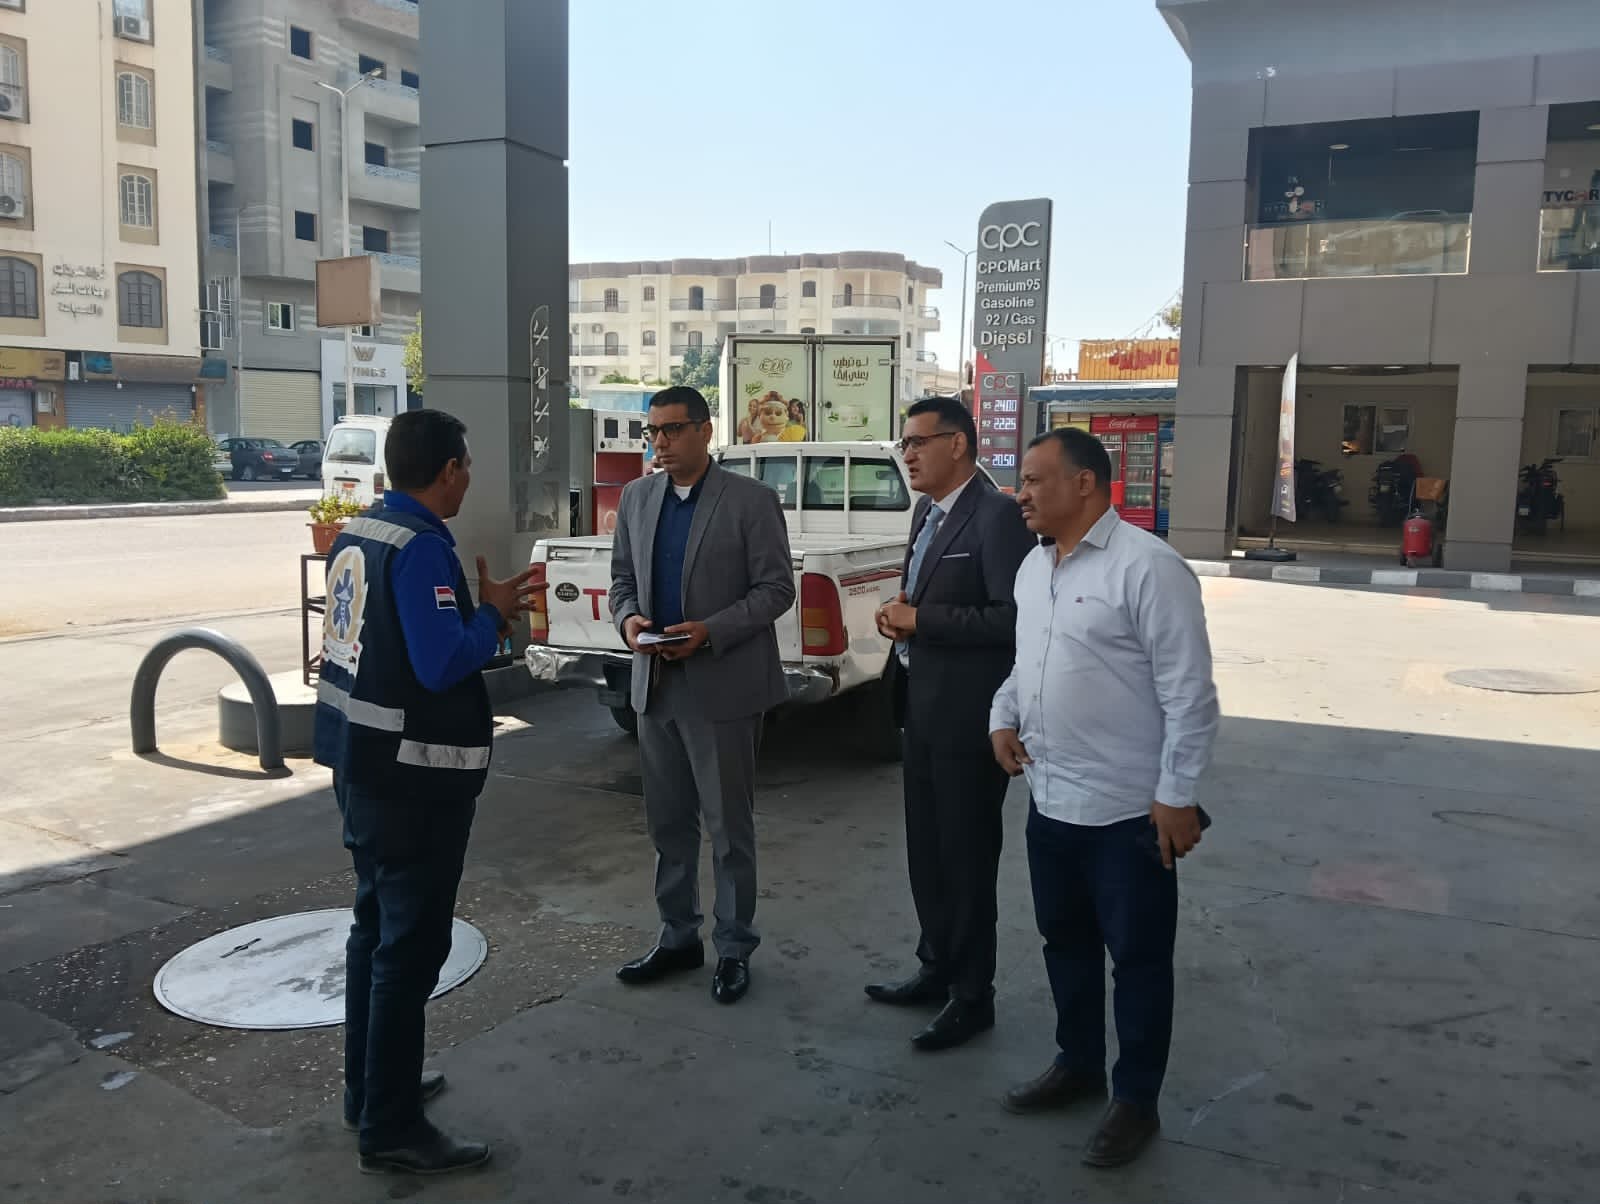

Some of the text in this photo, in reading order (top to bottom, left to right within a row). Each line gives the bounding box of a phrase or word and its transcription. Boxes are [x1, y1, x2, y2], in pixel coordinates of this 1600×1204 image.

[978, 258, 1041, 274] CPCMart
[976, 278, 1041, 293] Premium95
[981, 296, 1035, 309] Gasoline
[985, 313, 1001, 326] 92
[1011, 312, 1036, 325] Gas
[981, 328, 1032, 346] Diesel
